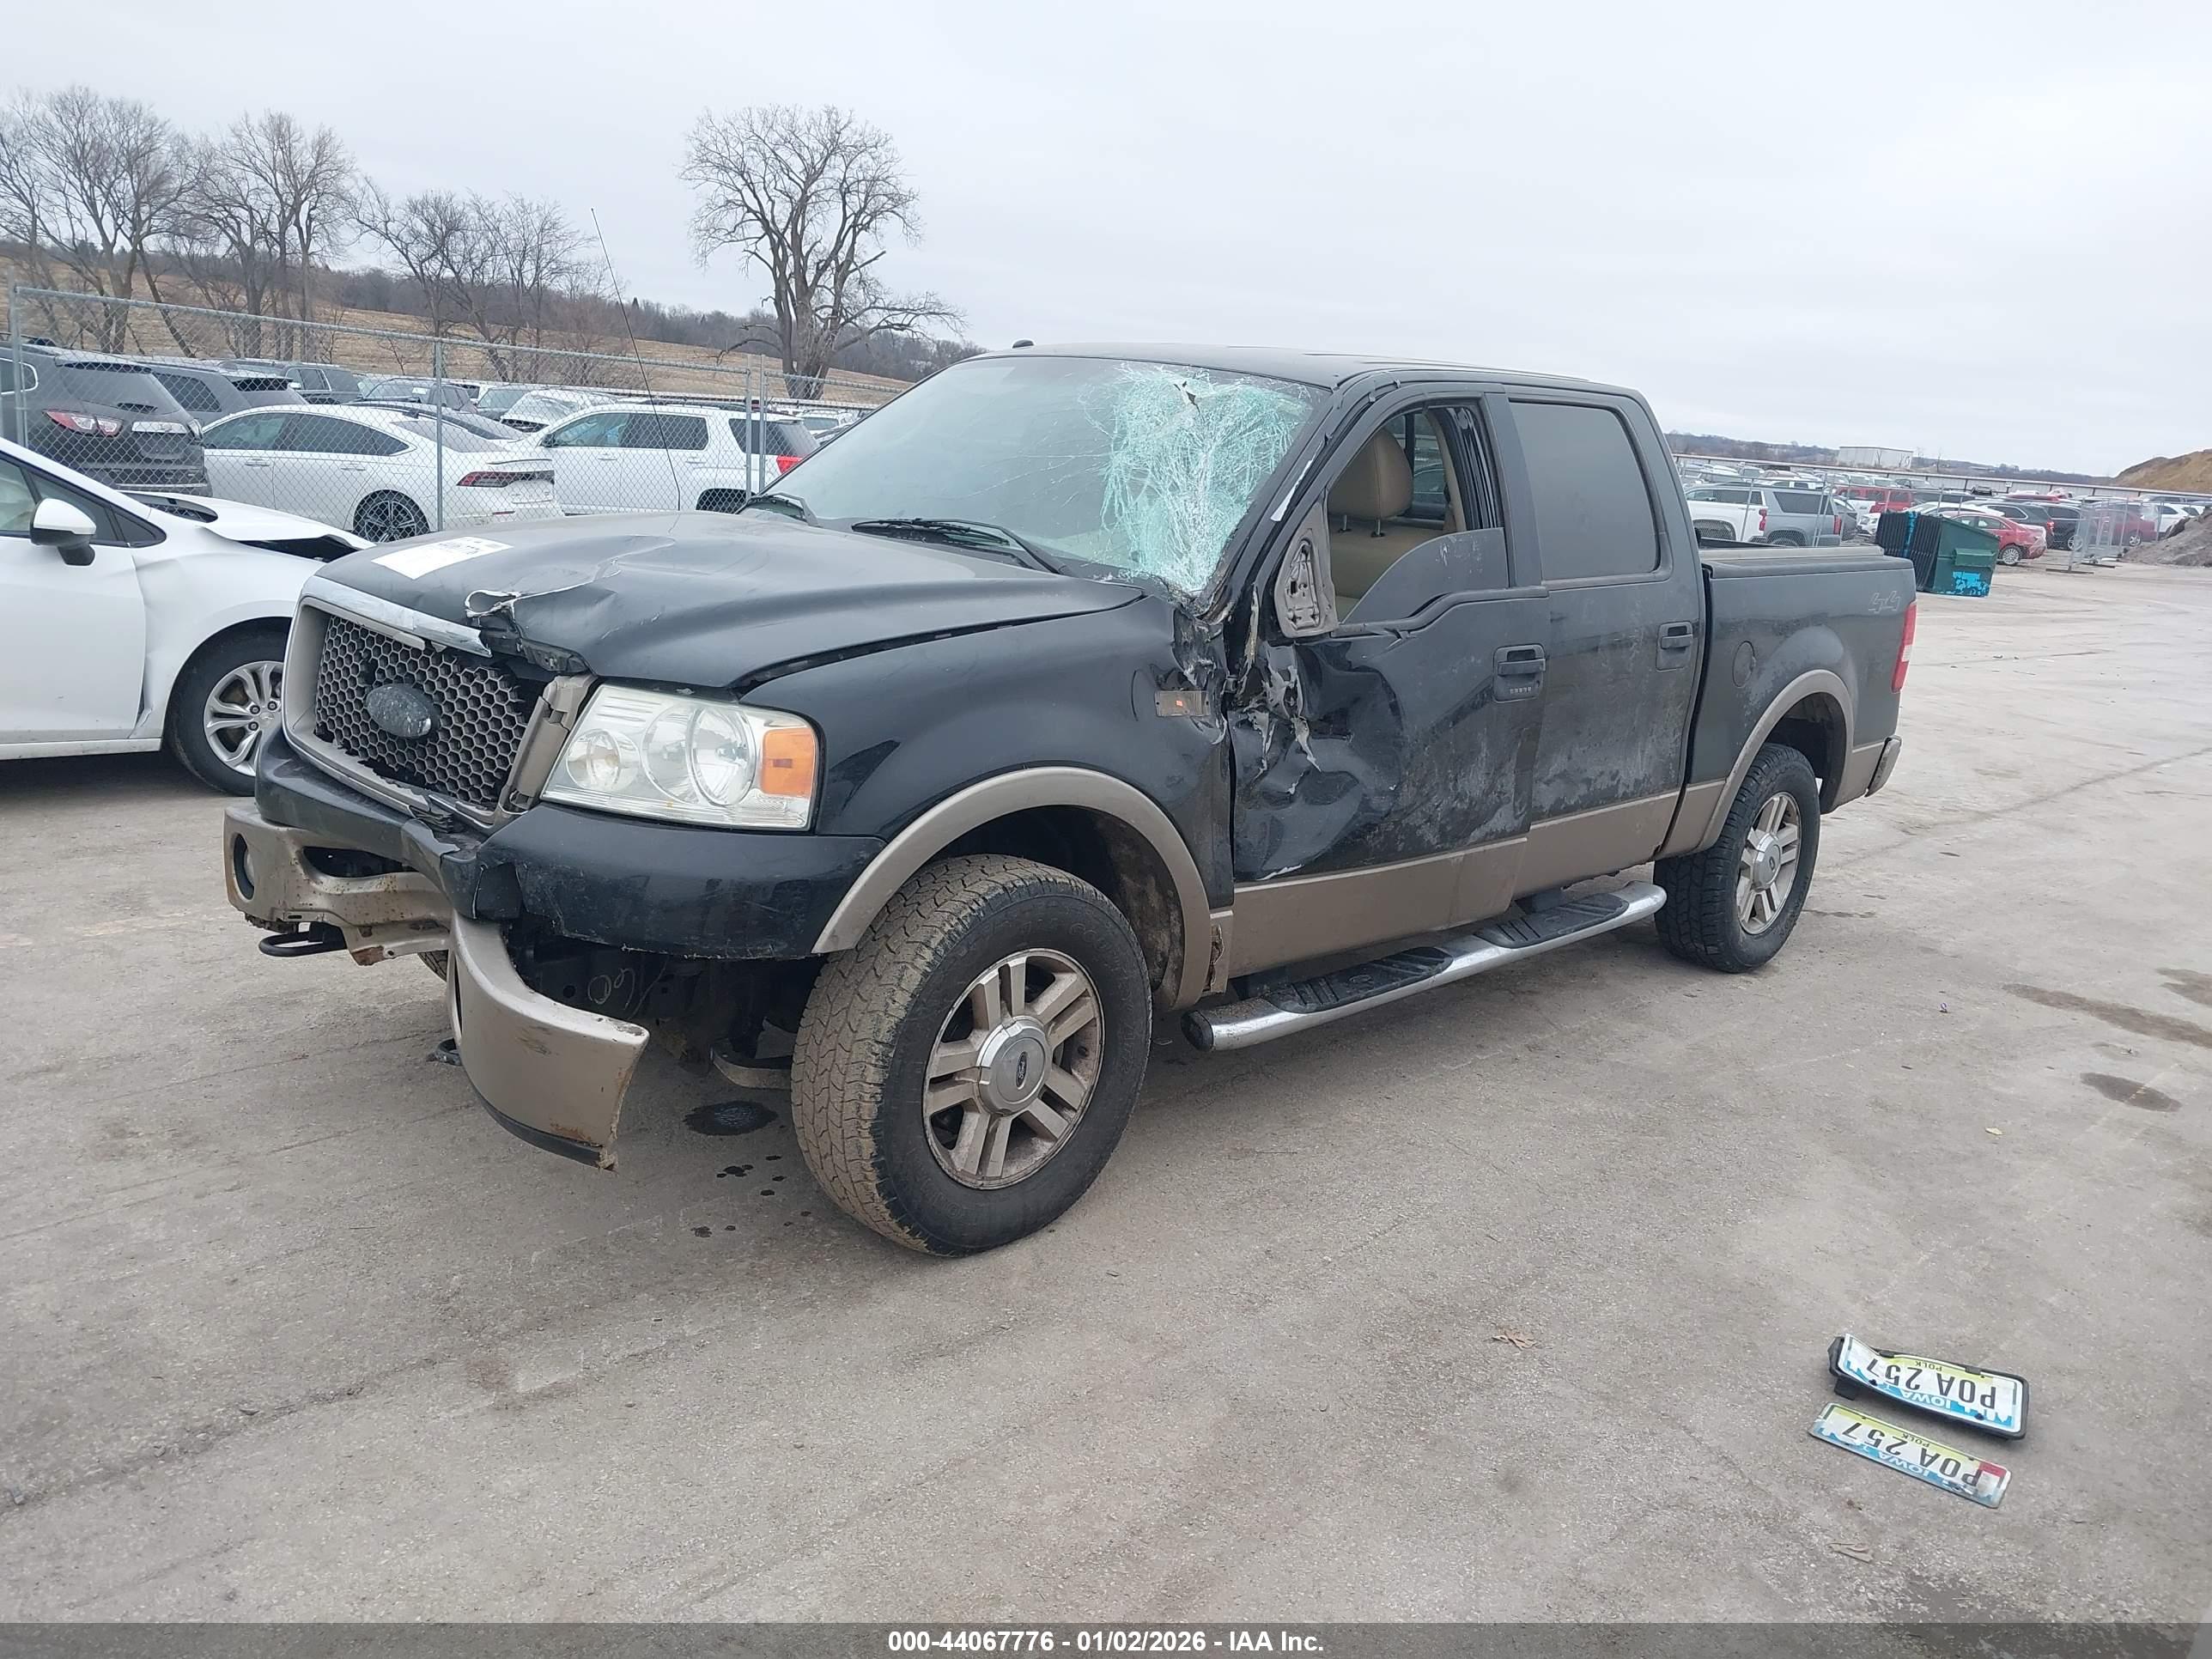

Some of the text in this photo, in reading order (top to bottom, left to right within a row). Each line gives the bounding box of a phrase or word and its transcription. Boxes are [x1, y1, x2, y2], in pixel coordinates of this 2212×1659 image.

[1866, 1358, 1923, 1391] 257
[1915, 1359, 1942, 1372] POLK
[1900, 1389, 1951, 1409] IOWA
[1842, 1422, 1908, 1456] 257
[1902, 1432, 1930, 1448] POLK
[1878, 1451, 1930, 1477] IOWA
